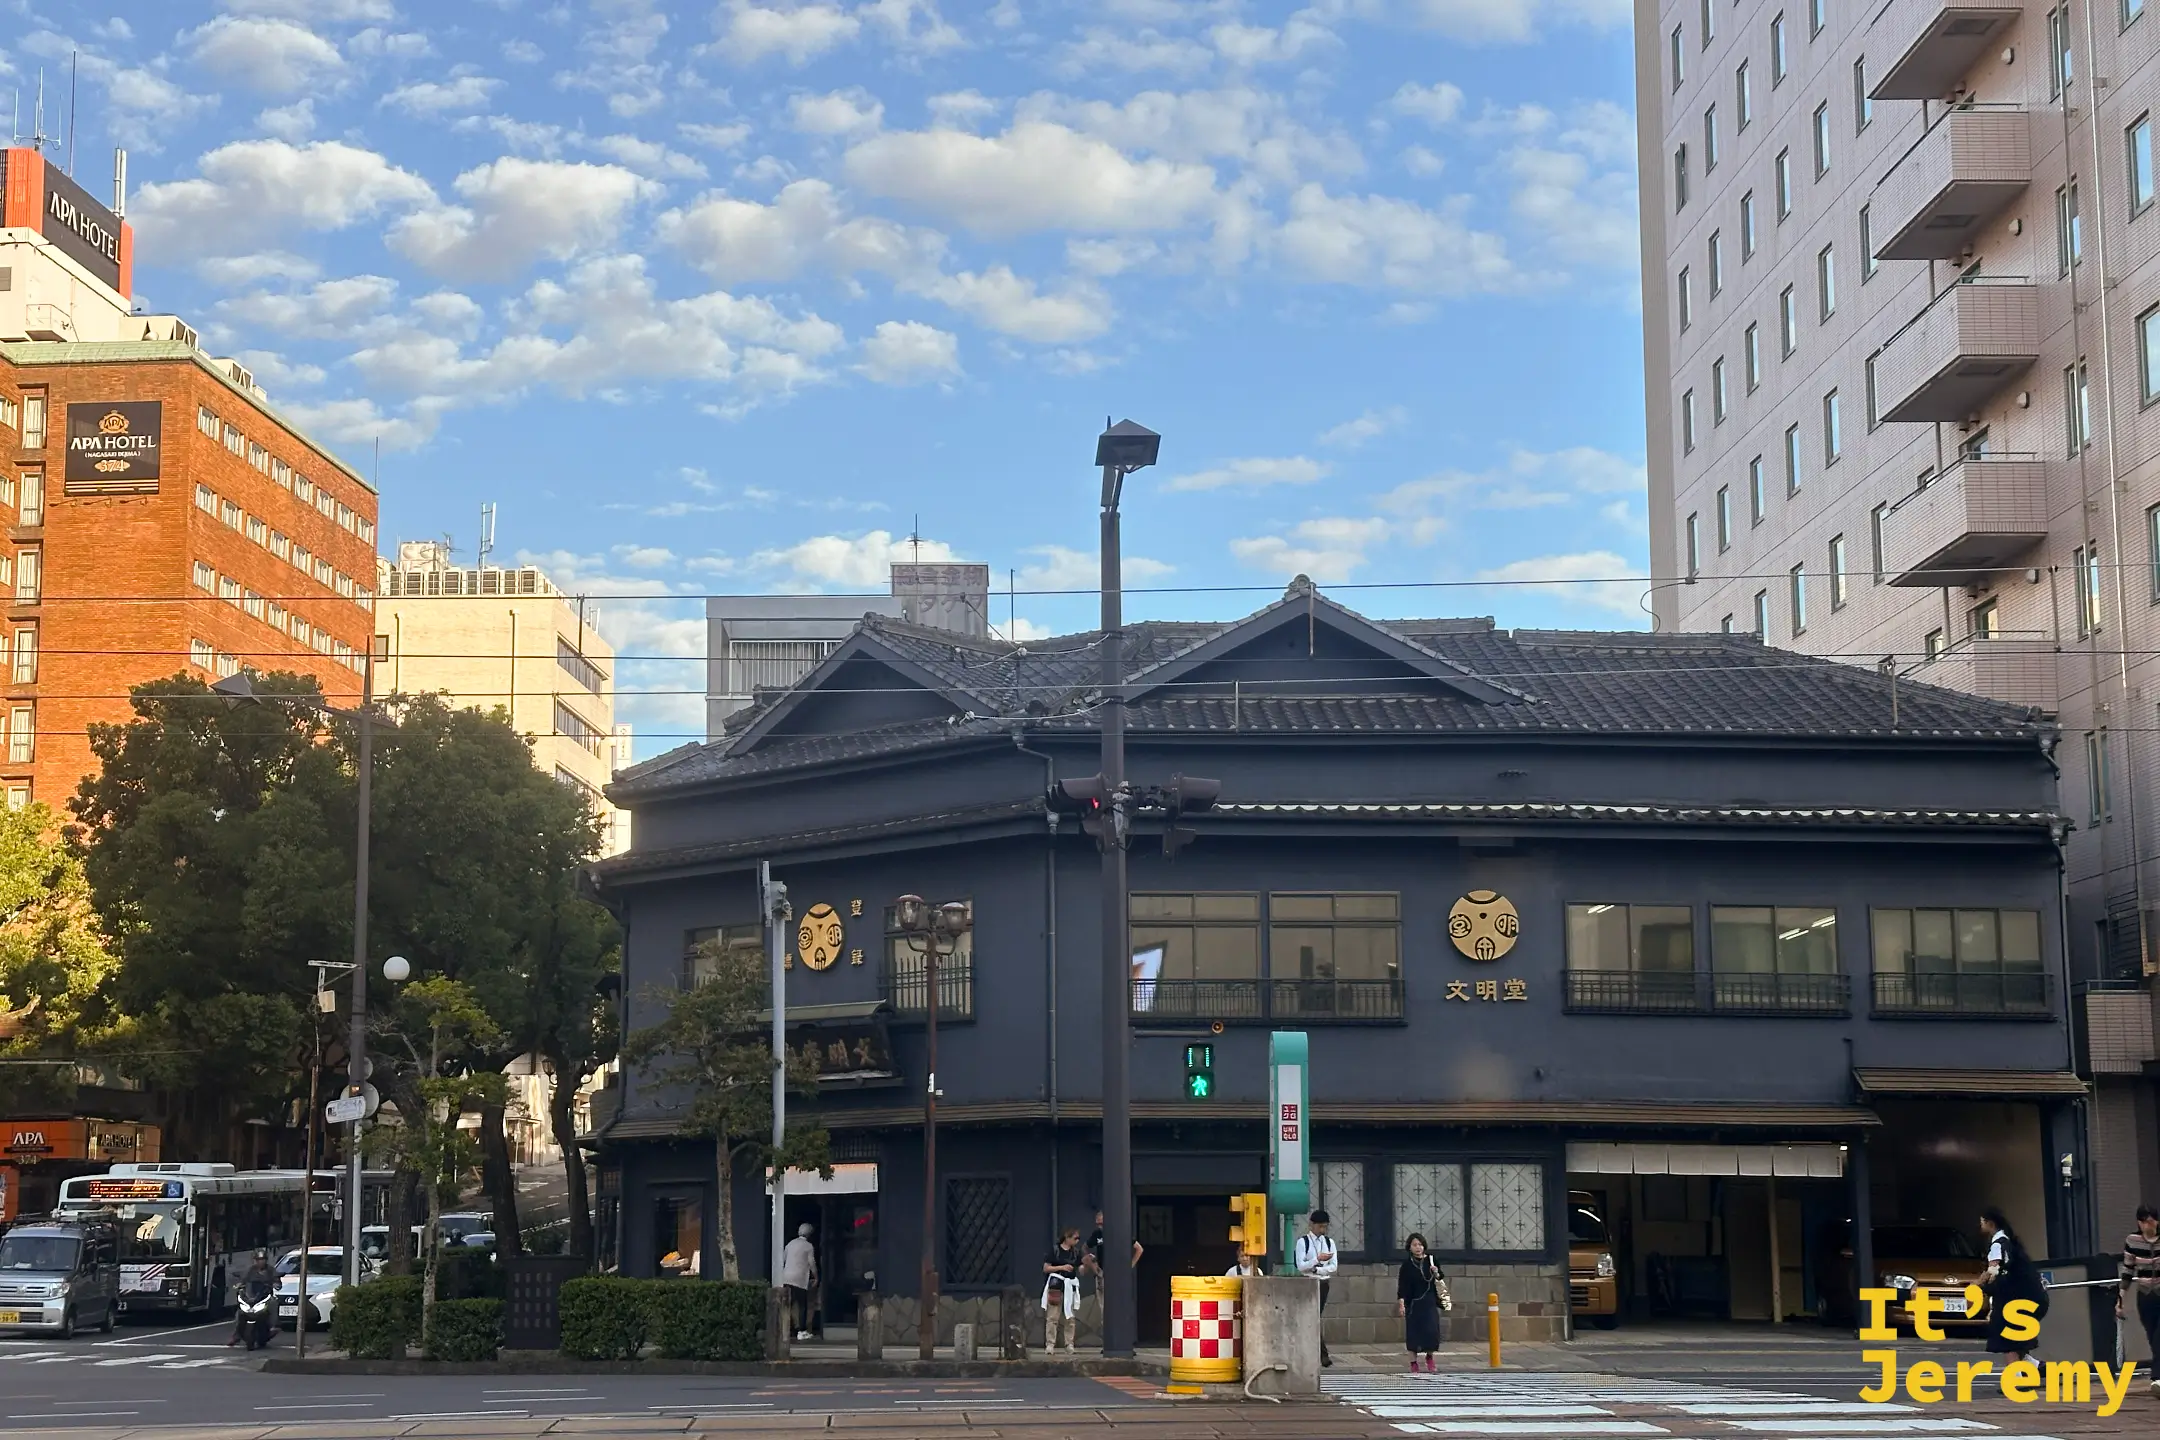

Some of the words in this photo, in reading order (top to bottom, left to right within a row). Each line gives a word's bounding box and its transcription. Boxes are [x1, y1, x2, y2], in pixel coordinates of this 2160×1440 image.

[50, 191, 78, 232] APA
[80, 212, 122, 265] HOTEL
[70, 437, 102, 450] APA
[104, 435, 156, 450] HOTEL
[100, 459, 125, 472] 374
[1445, 978, 1528, 1002] 文明堂
[13, 1132, 45, 1145] APA
[18, 1154, 37, 1165] 374
